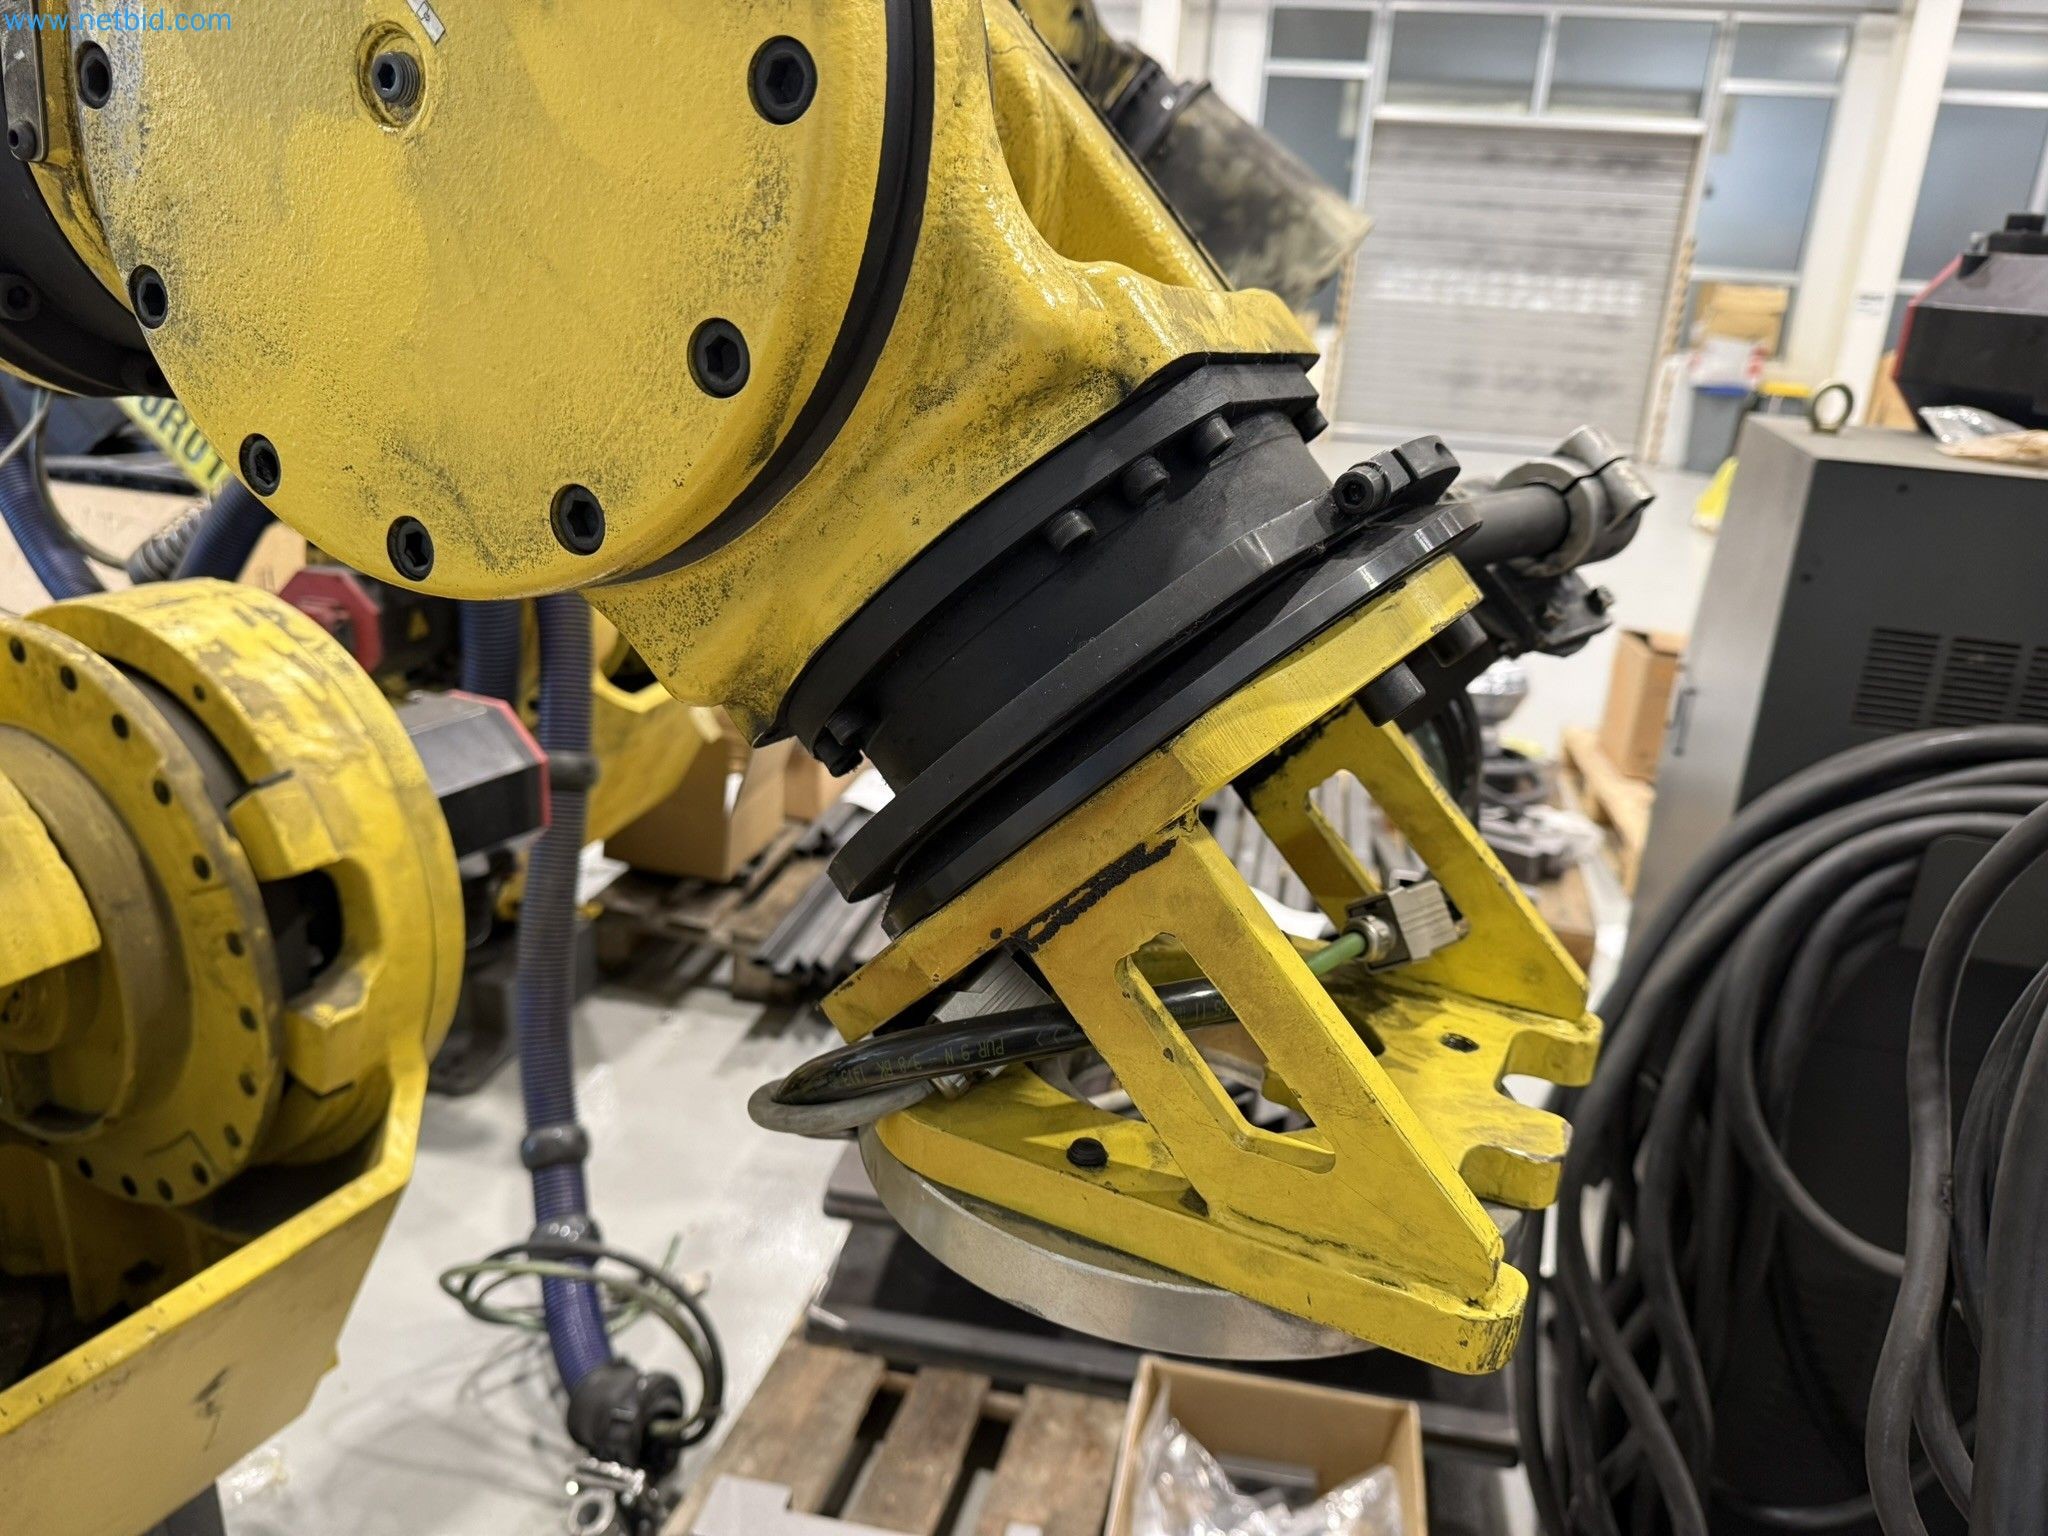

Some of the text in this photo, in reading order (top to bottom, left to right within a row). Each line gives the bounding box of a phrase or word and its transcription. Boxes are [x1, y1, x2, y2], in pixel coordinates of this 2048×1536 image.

[945, 1048, 954, 1065] N
[961, 1044, 970, 1062] 9
[978, 1037, 1004, 1059] PUR
[897, 1053, 922, 1072] 3/8
